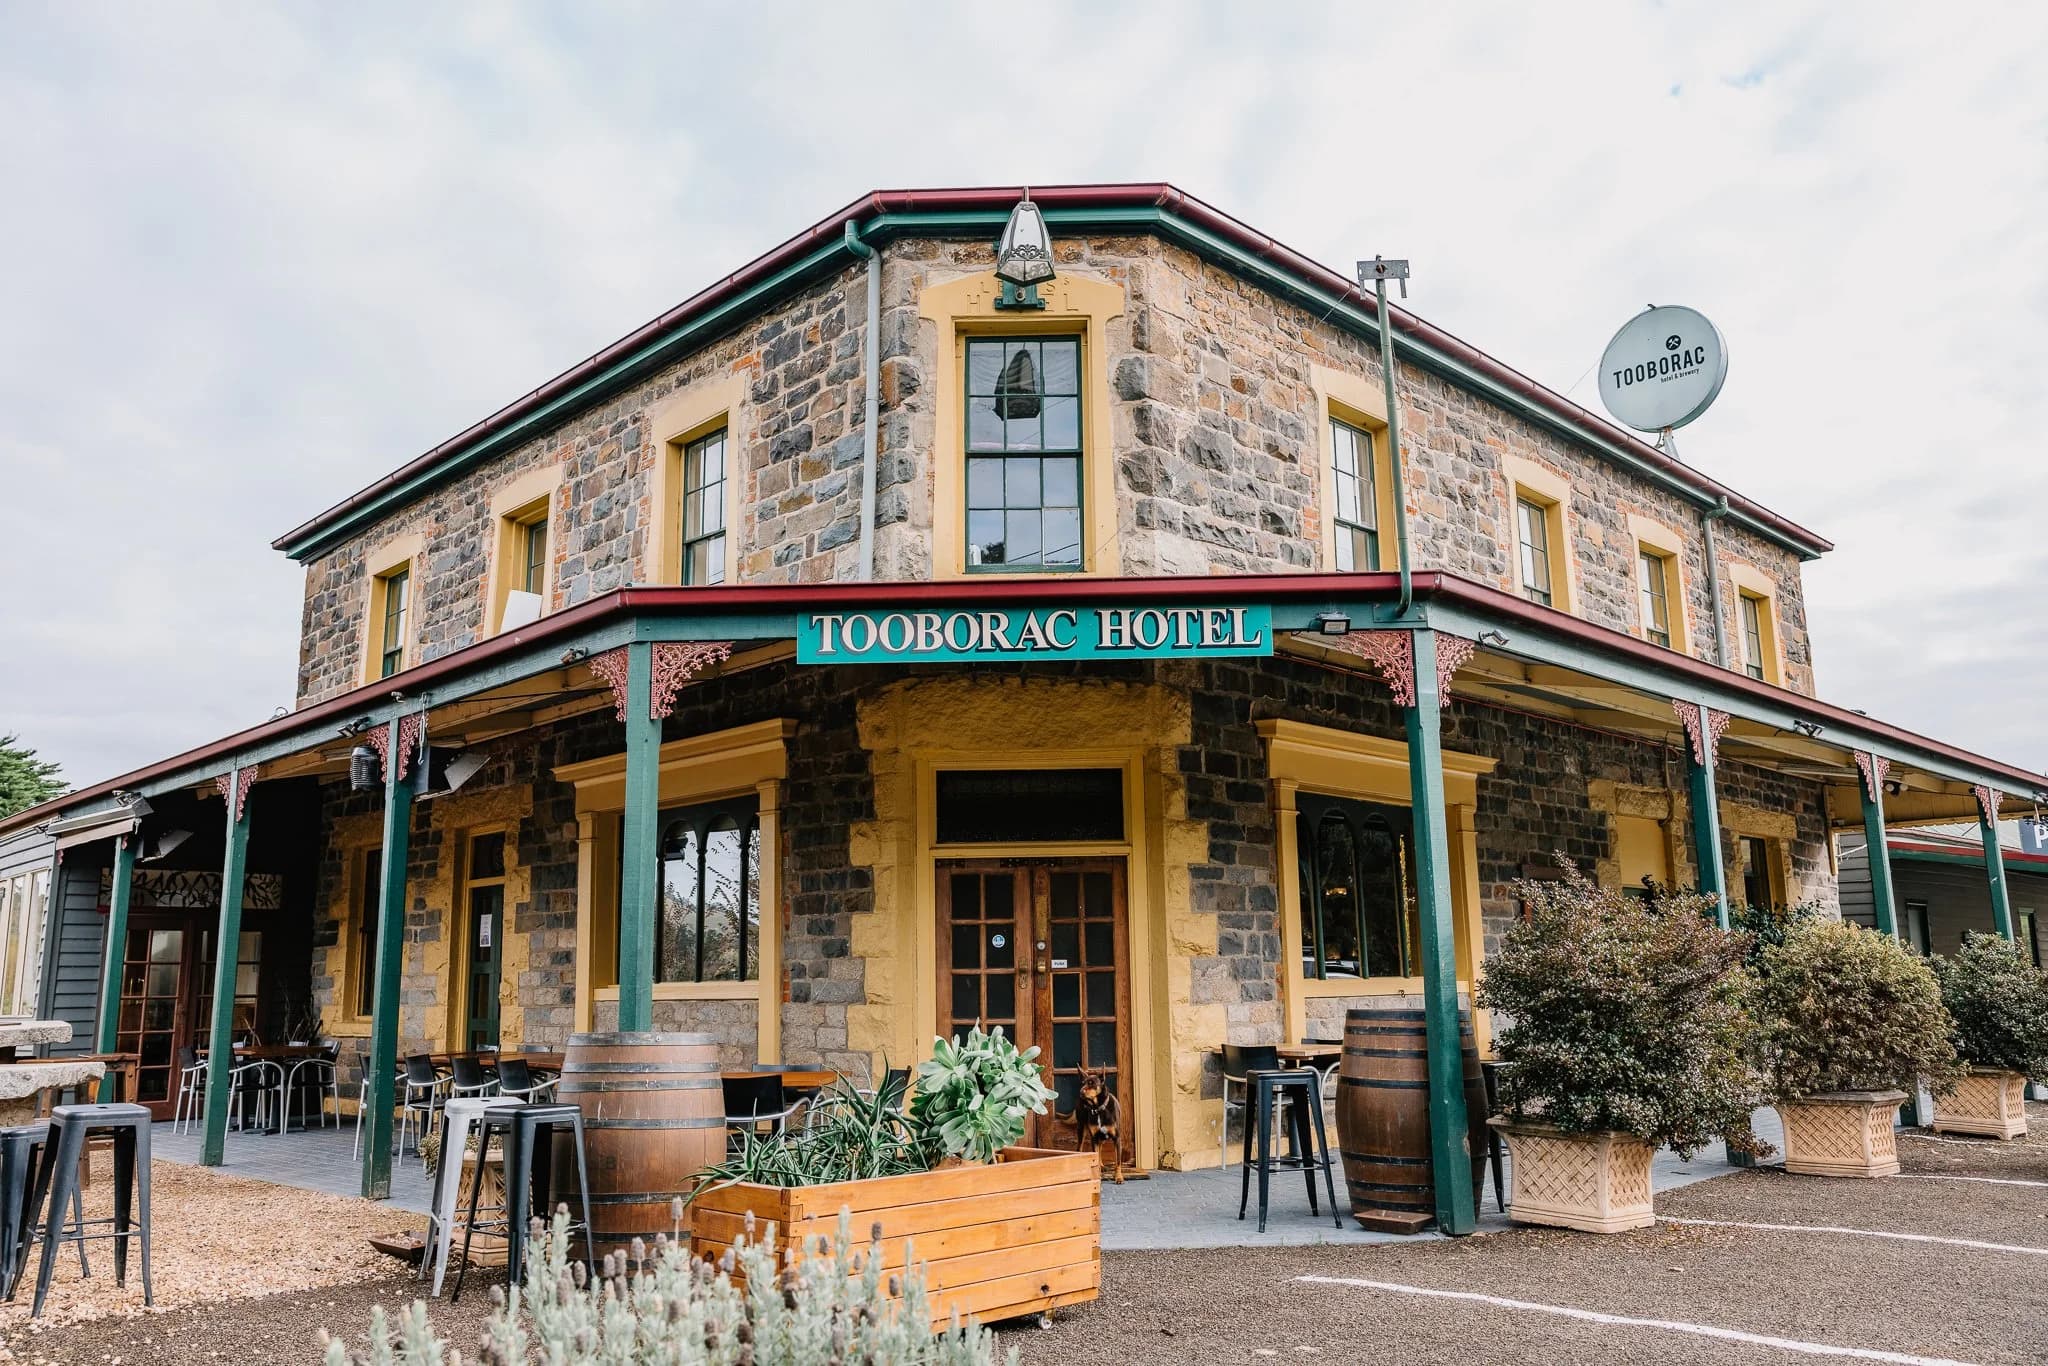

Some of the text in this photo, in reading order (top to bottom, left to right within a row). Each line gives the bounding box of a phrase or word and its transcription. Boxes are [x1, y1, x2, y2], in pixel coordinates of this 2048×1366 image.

[1613, 346, 1705, 389] TOOBORAC
[1660, 374, 1674, 383] hotel
[1679, 368, 1700, 378] brewery
[811, 607, 1262, 655] TOOBORAC HOTEL
